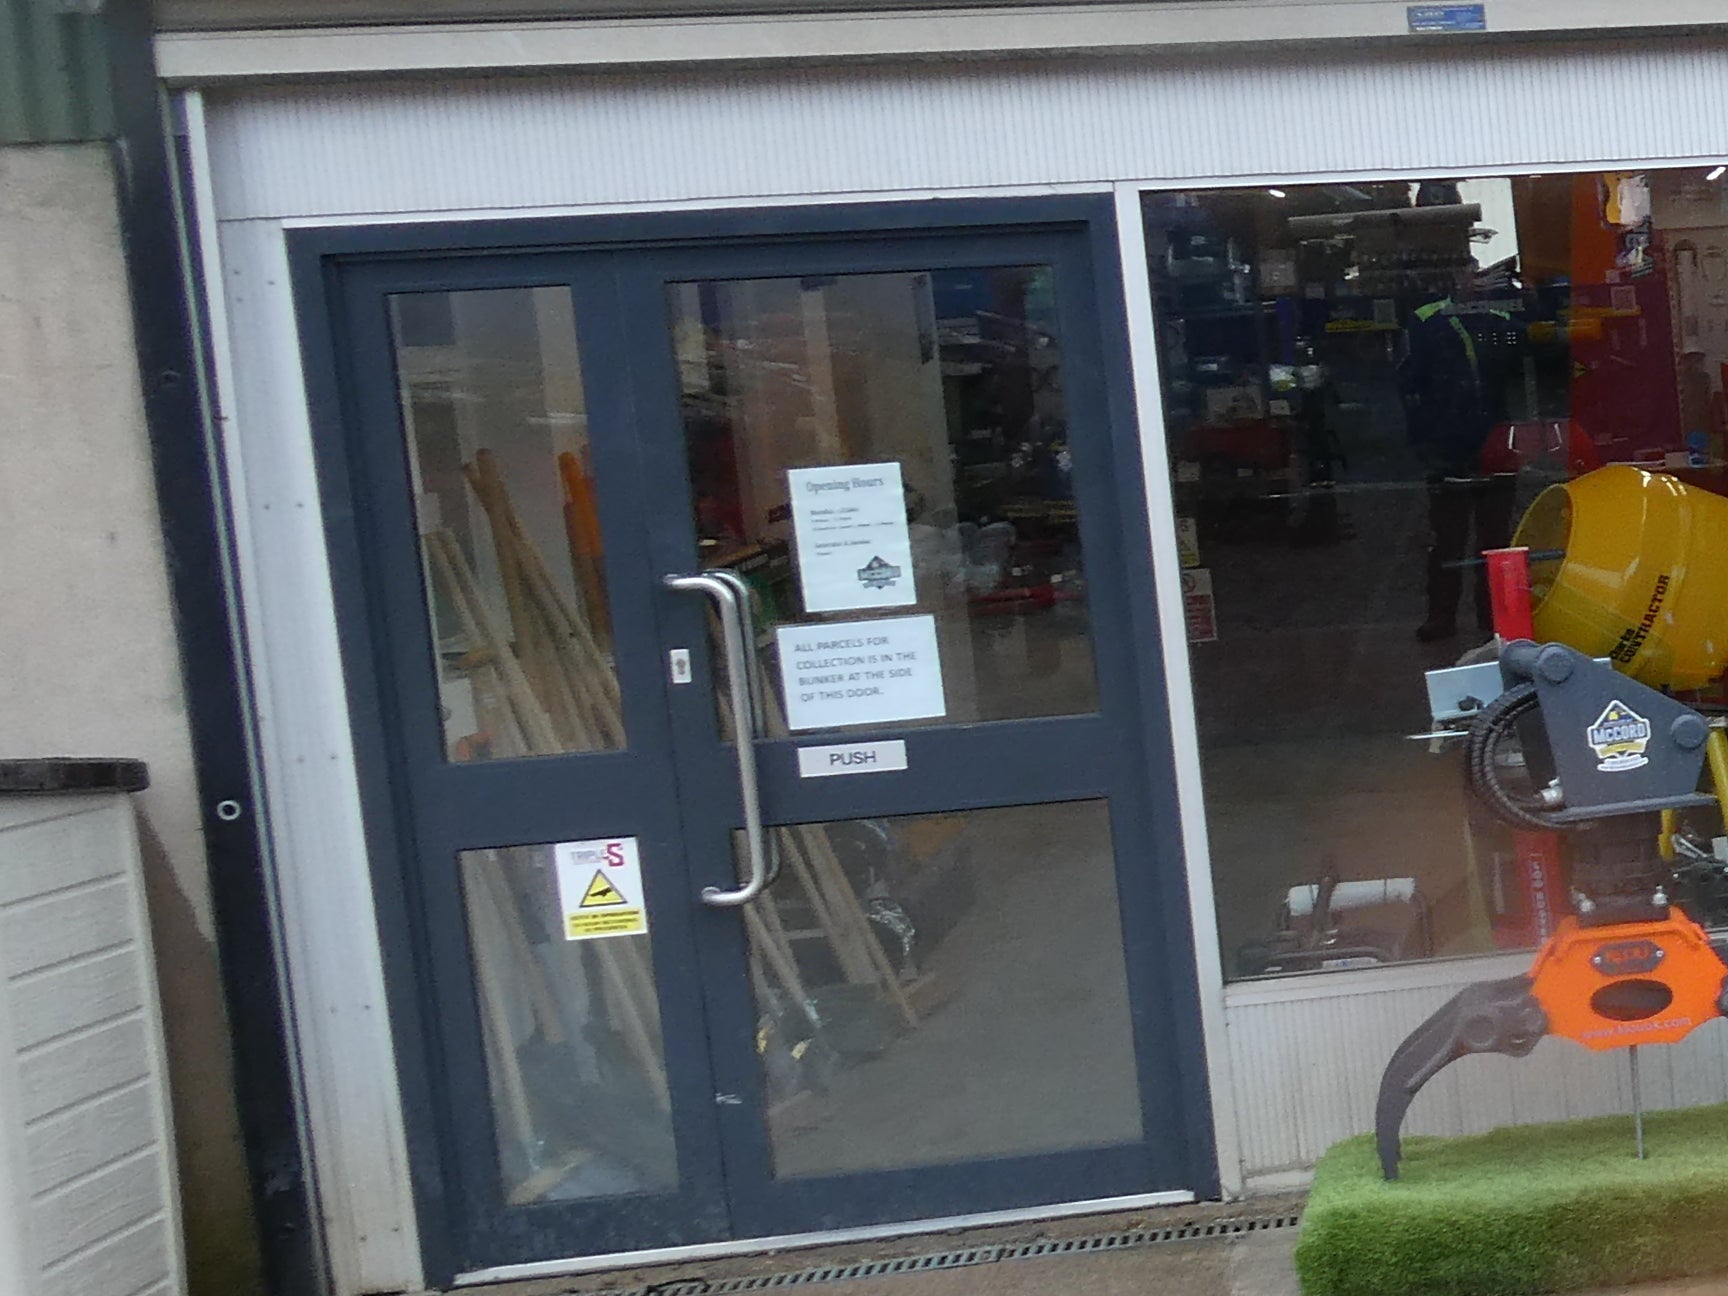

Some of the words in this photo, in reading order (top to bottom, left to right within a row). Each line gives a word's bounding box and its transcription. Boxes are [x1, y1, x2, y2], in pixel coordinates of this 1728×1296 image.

[1620, 575, 1670, 663] CONTRACTOR
[794, 641, 813, 652] ALL
[817, 638, 864, 650] PARCELS
[867, 636, 889, 646] FOR
[796, 657, 864, 670] COLLECTION
[868, 655, 877, 664] IS
[881, 654, 892, 663] IN
[895, 651, 916, 661] THE
[798, 674, 844, 686] BUNKER
[848, 672, 860, 681] AT
[864, 671, 884, 680] THE
[889, 668, 912, 678] SIDE
[801, 692, 815, 702] OF
[819, 690, 844, 700] THIS
[829, 751, 877, 766] PUSH
